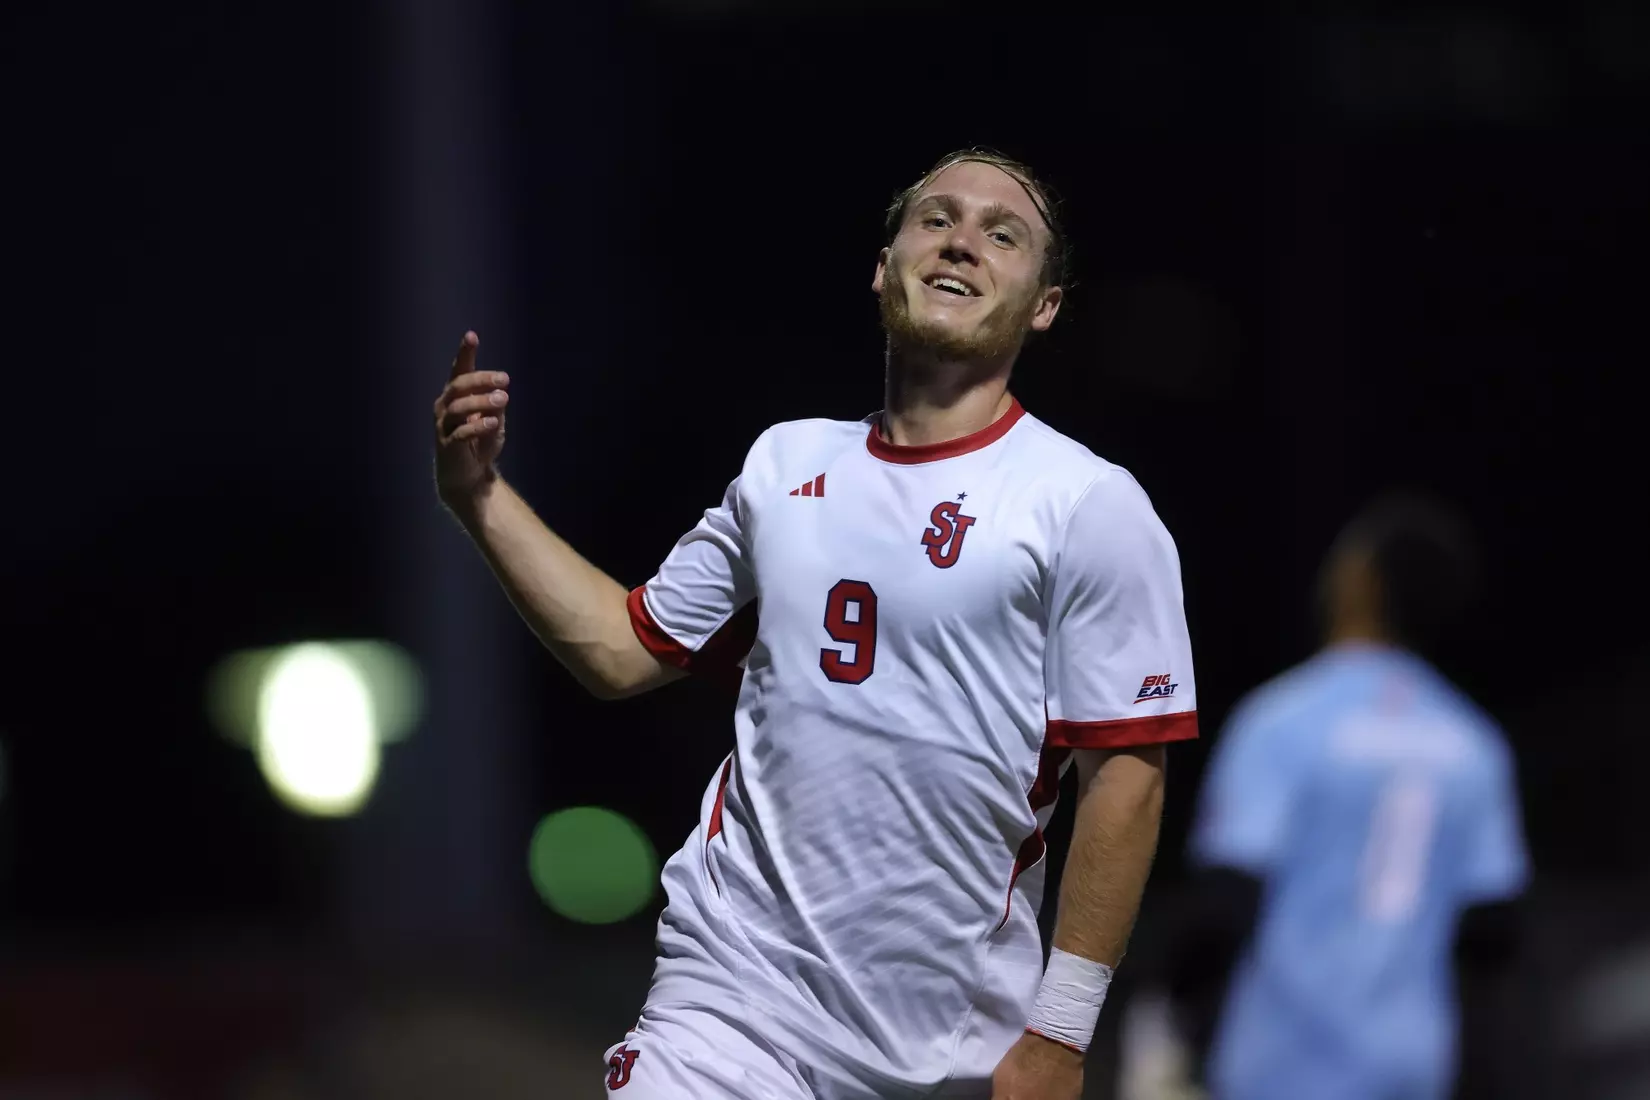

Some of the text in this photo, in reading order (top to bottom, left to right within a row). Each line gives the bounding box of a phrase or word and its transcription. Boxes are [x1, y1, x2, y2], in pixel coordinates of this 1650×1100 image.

[819, 578, 878, 685] 9
[1141, 673, 1171, 687] BIG
[1136, 683, 1179, 698] EAST
